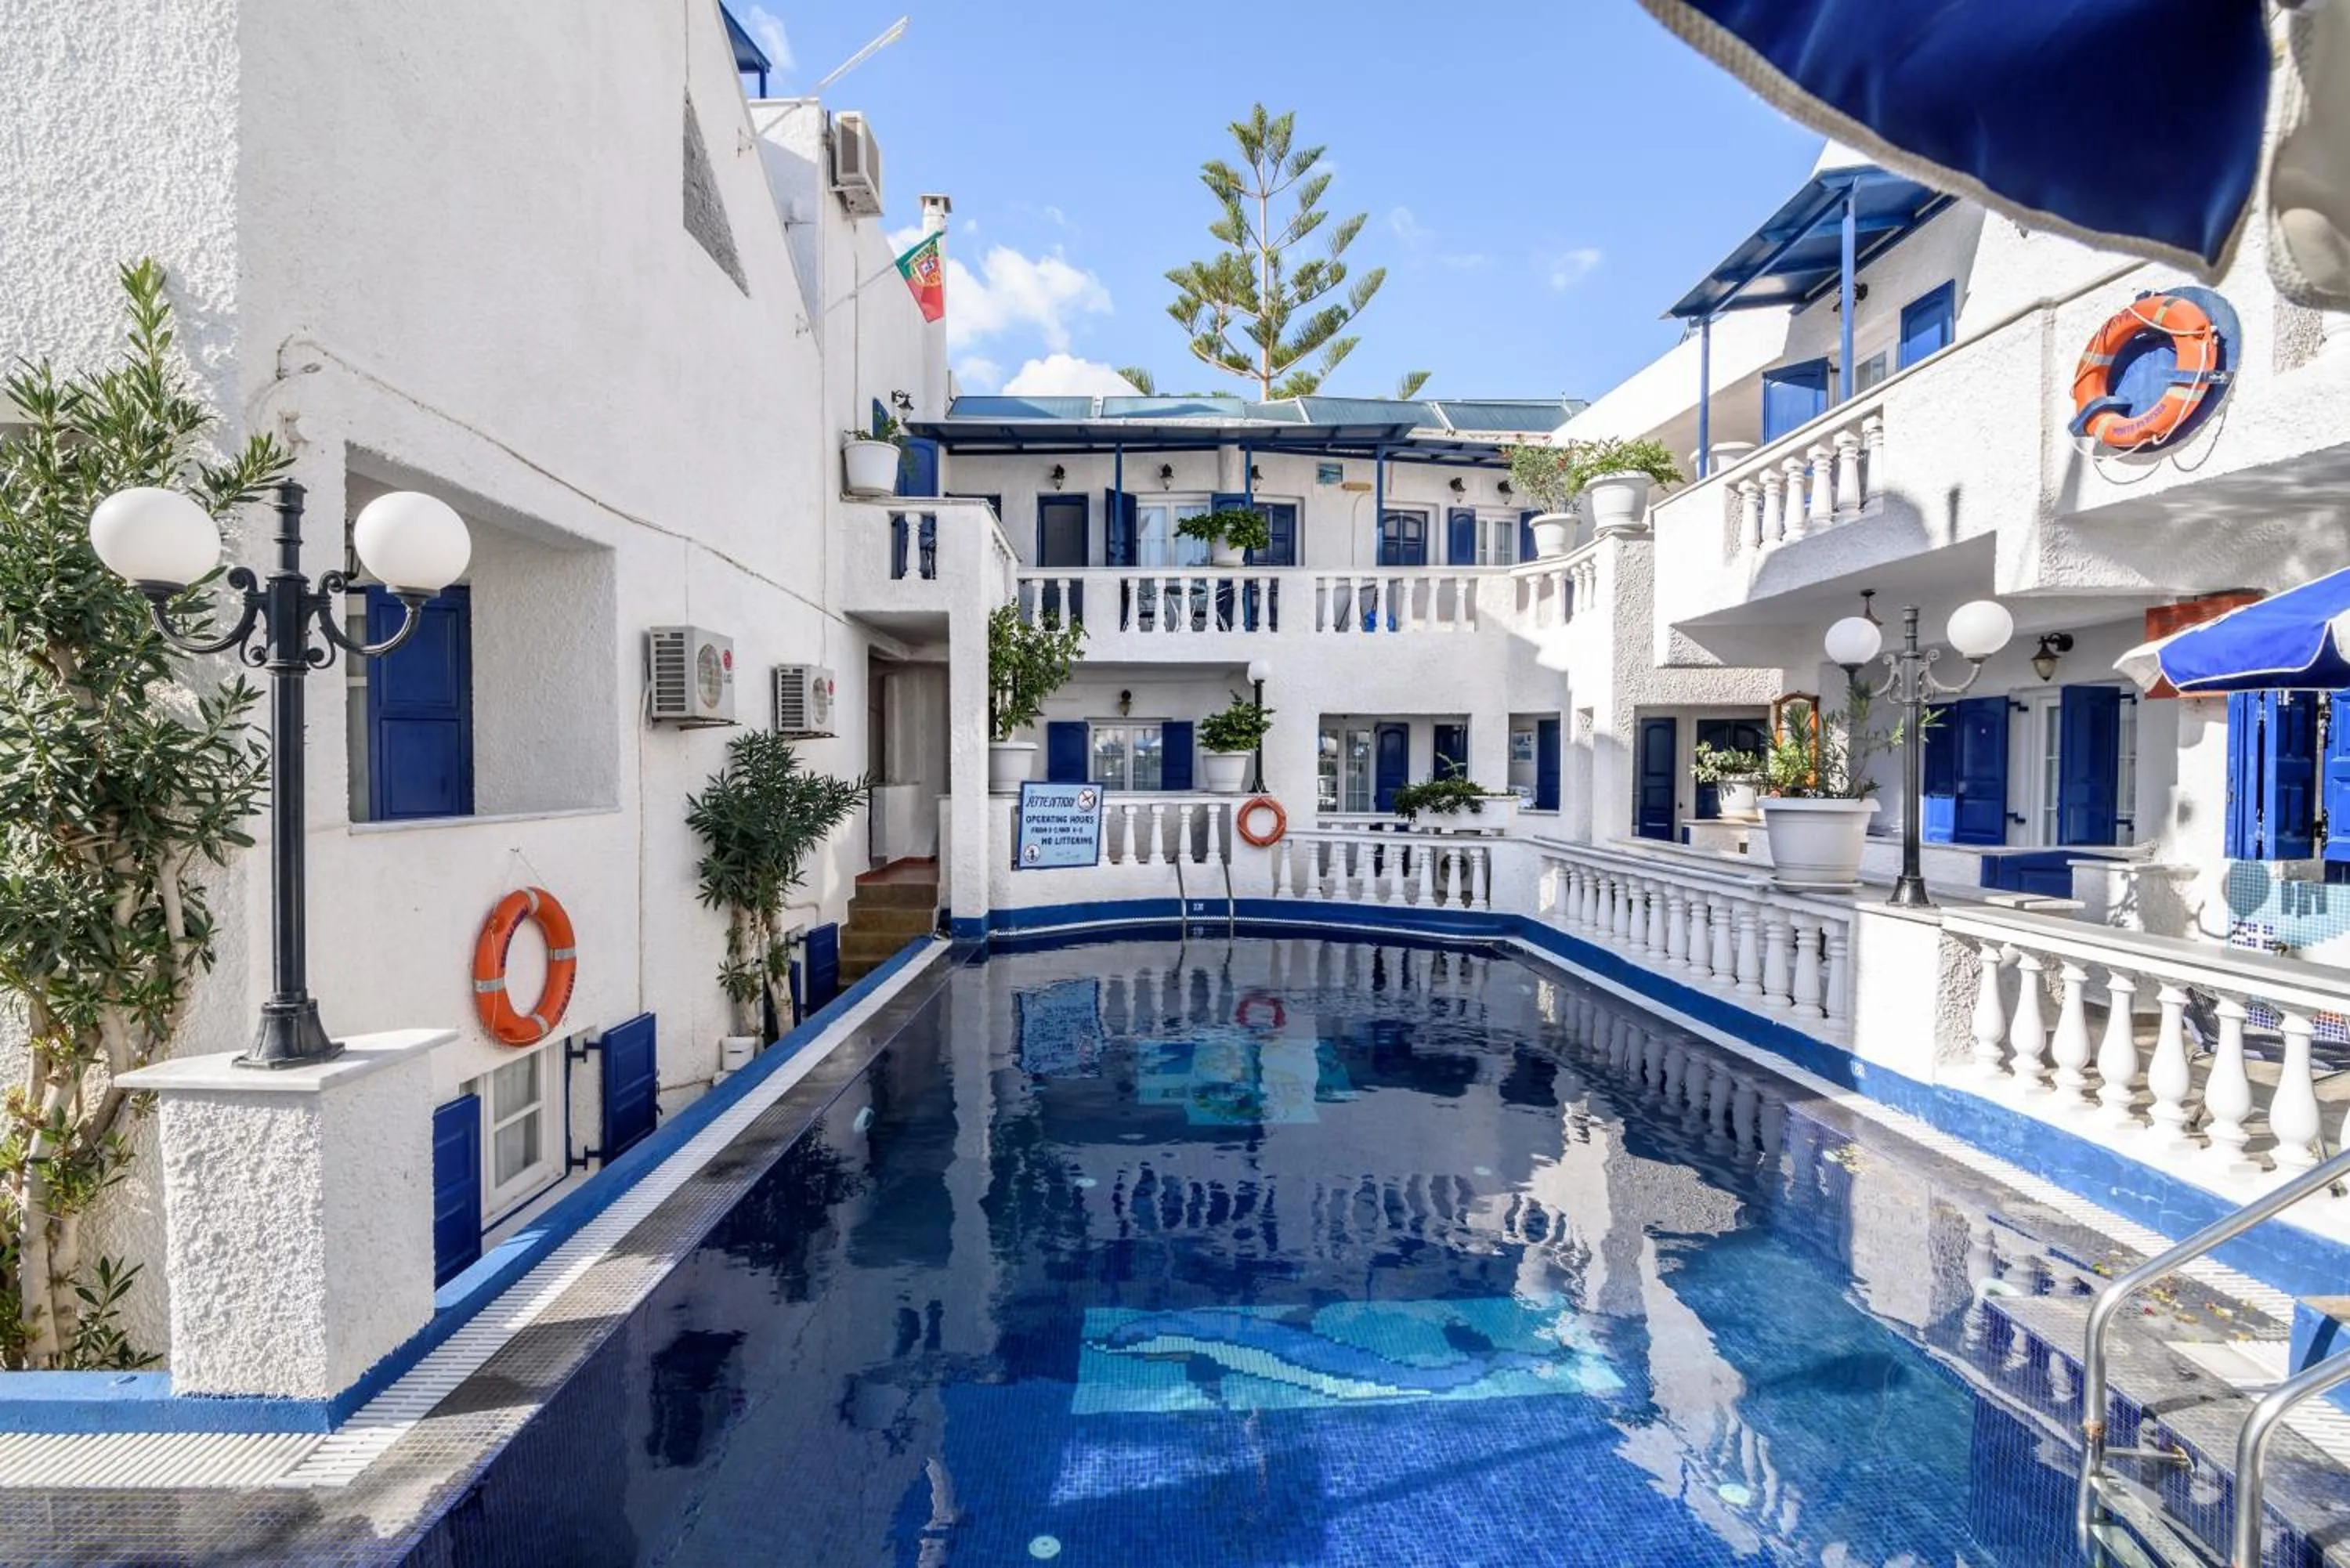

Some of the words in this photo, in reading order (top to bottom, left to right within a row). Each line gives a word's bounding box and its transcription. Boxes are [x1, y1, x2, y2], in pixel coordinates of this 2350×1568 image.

[1025, 815, 1068, 824] OPERATING
[1070, 815, 1094, 824] HOURS
[1041, 836, 1052, 845] NO
[1054, 836, 1094, 845] LITTERING
